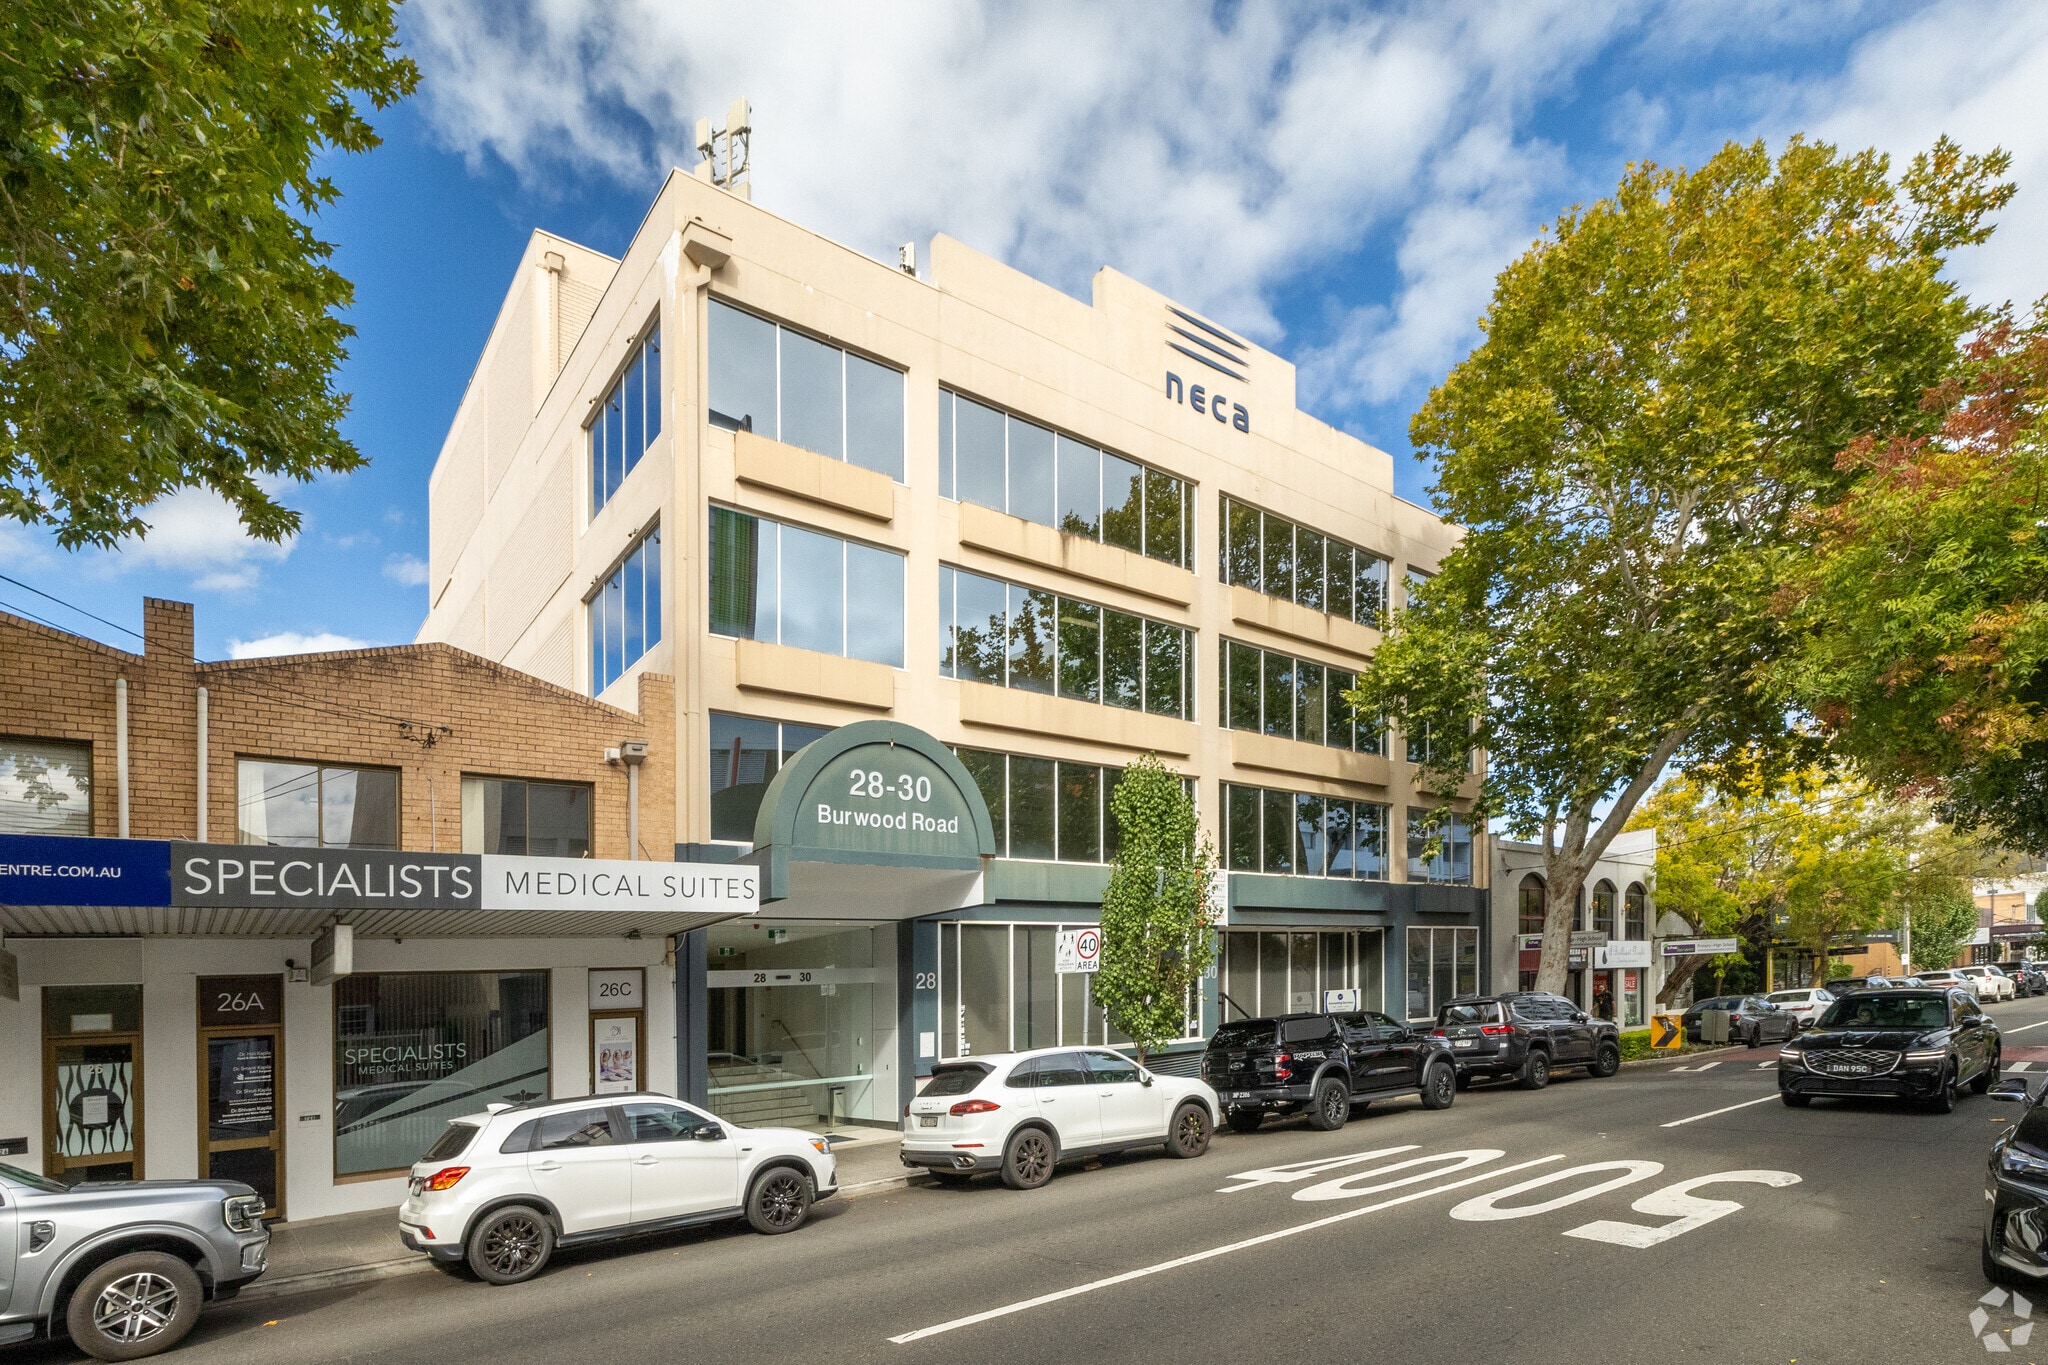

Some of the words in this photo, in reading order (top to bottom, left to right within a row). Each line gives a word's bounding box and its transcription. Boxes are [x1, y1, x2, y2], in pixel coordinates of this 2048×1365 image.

[1166, 370, 1249, 434] neca
[850, 769, 932, 803] 28-30
[818, 804, 906, 830] Burwood
[912, 812, 958, 834] Road
[184, 858, 473, 898] SPECIALISTS
[506, 871, 650, 897] MEDICAL
[663, 876, 755, 899] SUITES
[1080, 938, 1096, 952] 40
[1077, 961, 1098, 970] AREA
[1204, 966, 1217, 979] 30
[753, 973, 766, 983] 28
[799, 972, 811, 982] 30
[915, 972, 936, 989] 28
[600, 982, 631, 997] 26C
[217, 992, 265, 1011] 26A
[345, 1042, 467, 1065] SPECIALISTS
[89, 1064, 103, 1074] 26
[358, 1064, 411, 1075] MEDICAL
[415, 1060, 454, 1071] SUITES
[1215, 1144, 1506, 1202] 40
